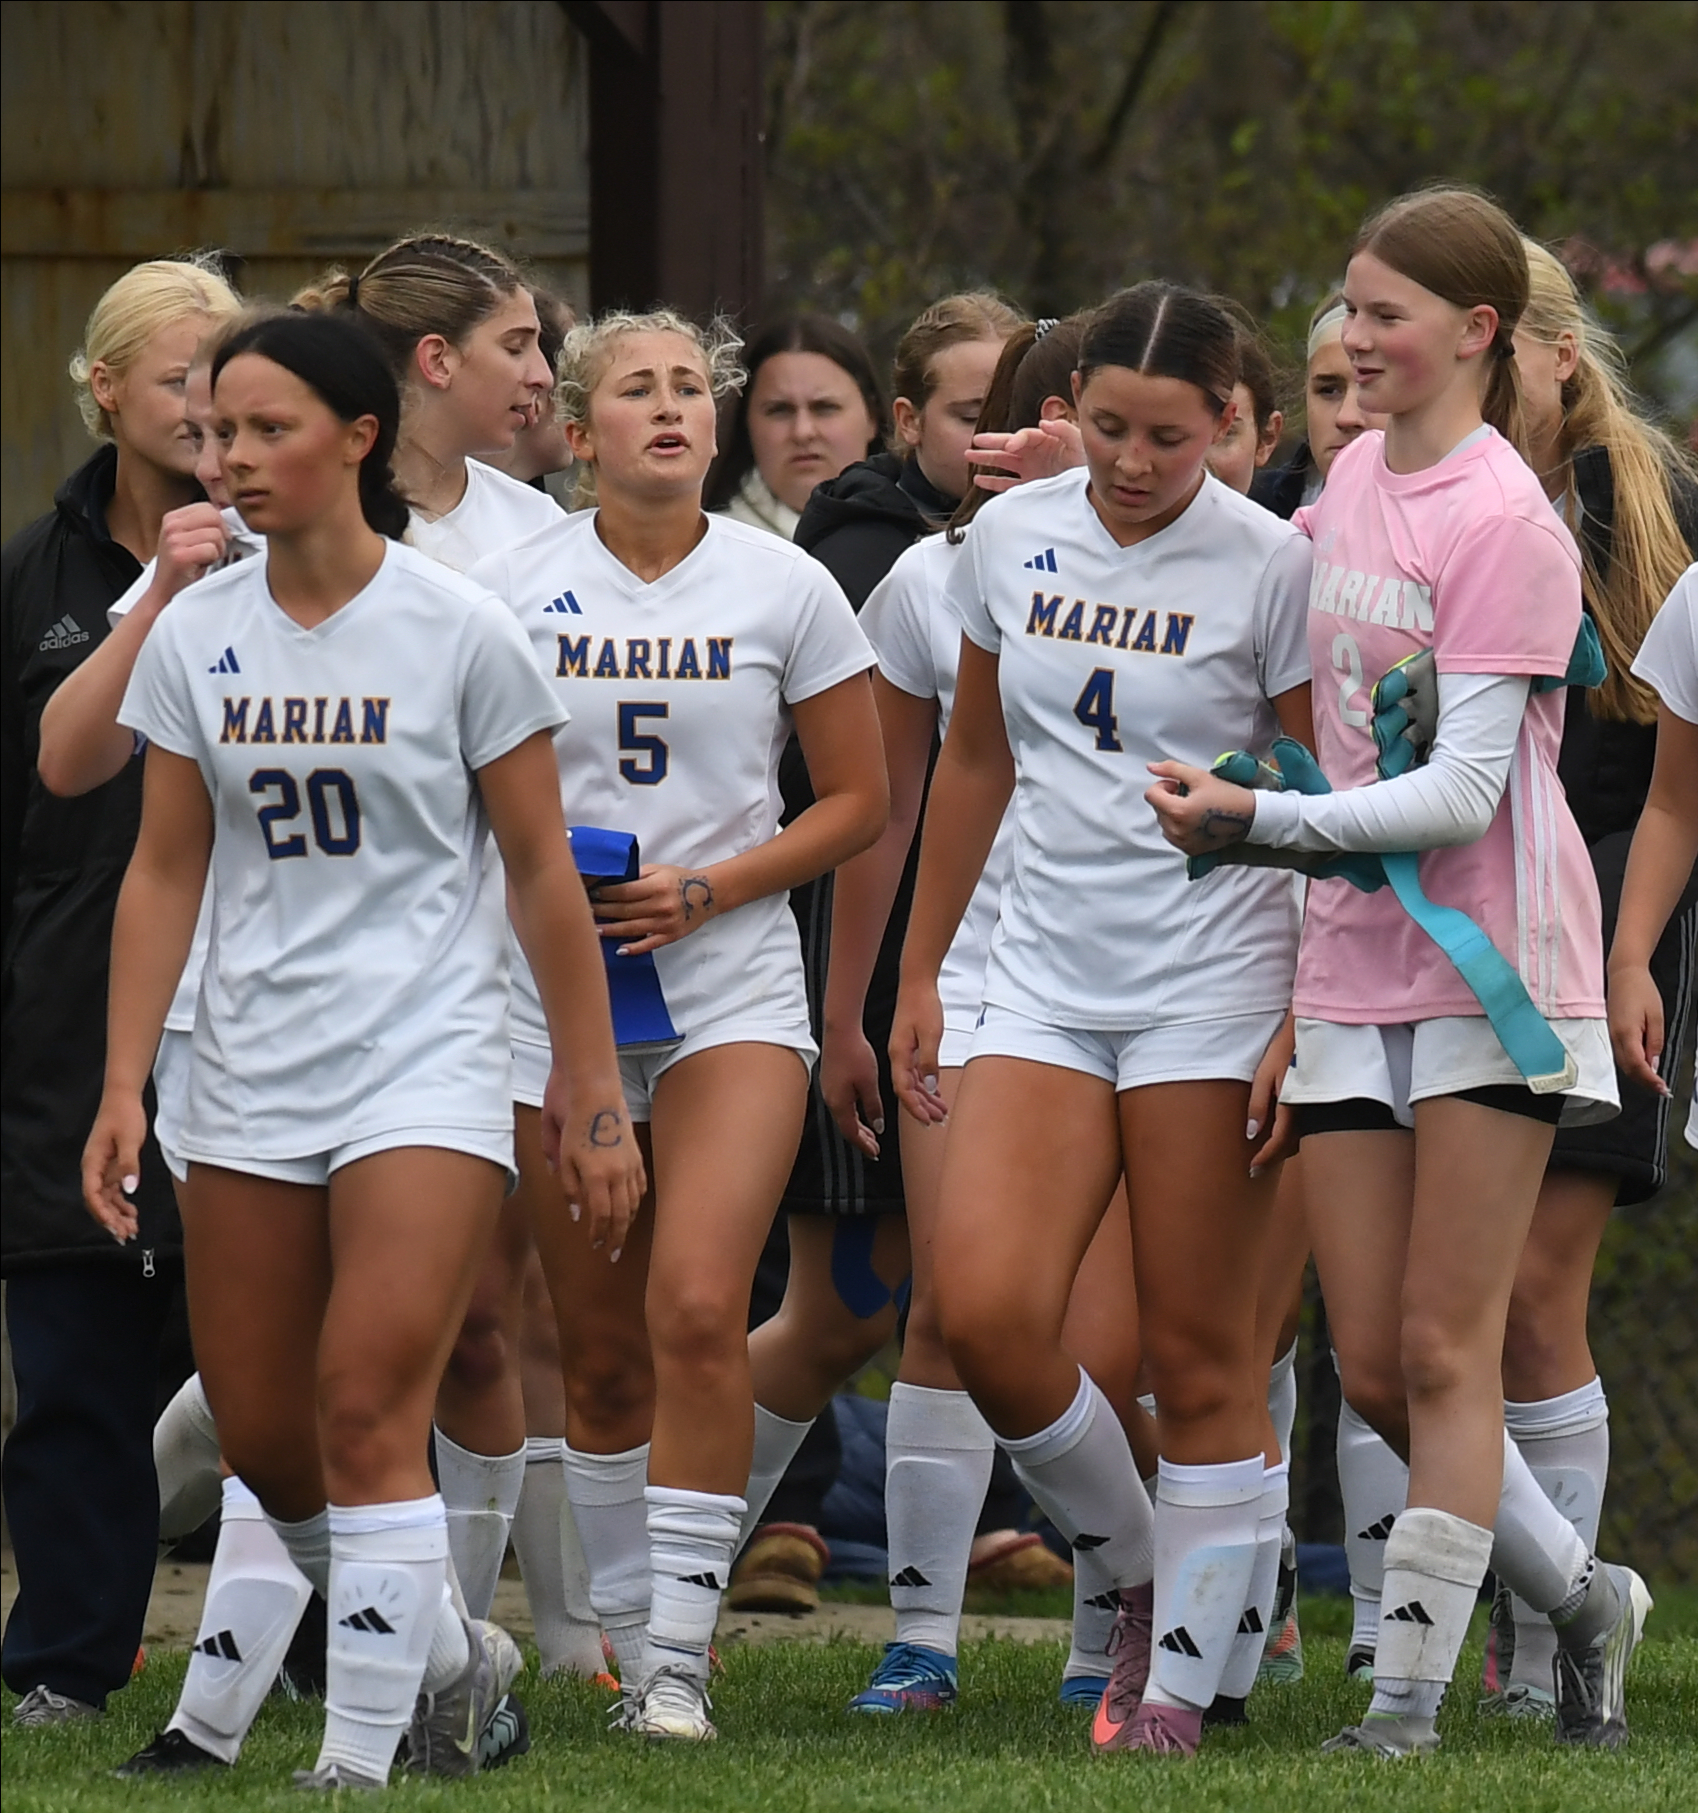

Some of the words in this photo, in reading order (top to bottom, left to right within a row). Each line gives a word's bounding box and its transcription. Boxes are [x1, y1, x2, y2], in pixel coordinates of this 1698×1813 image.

[39, 631, 90, 651] adidas
[555, 633, 734, 681] MARIAN
[1025, 591, 1194, 657] MARIAN
[1073, 666, 1123, 753] 4
[1332, 633, 1367, 727] 2
[219, 697, 391, 745] MARIAN
[617, 701, 670, 786] 5
[248, 767, 363, 861] 20
